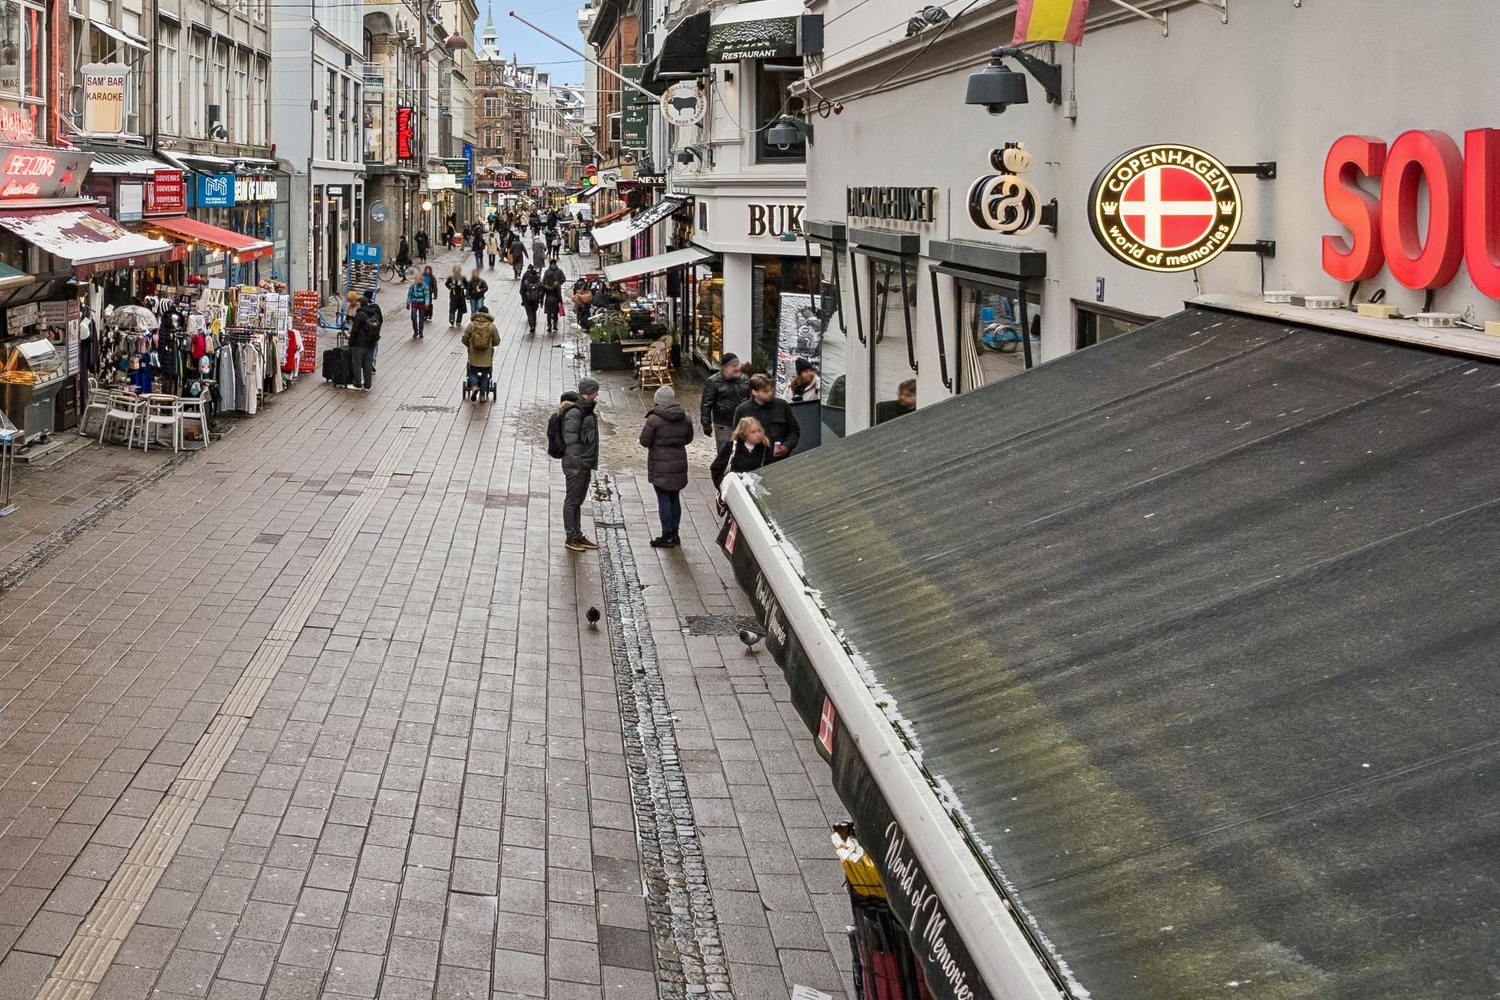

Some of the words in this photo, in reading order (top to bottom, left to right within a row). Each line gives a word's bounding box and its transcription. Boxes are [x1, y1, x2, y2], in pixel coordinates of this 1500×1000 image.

[722, 50, 777, 60] RESTAURANT
[108, 77, 123, 86] BAR
[87, 92, 123, 101] KARAOKE
[1108, 150, 1230, 193] COPENHAGEN
[639, 176, 664, 184] NEYE
[1109, 225, 1145, 259] world
[1146, 253, 1163, 265] of
[1166, 224, 1230, 265] memories
[885, 821, 918, 896] World
[910, 884, 928, 932] of
